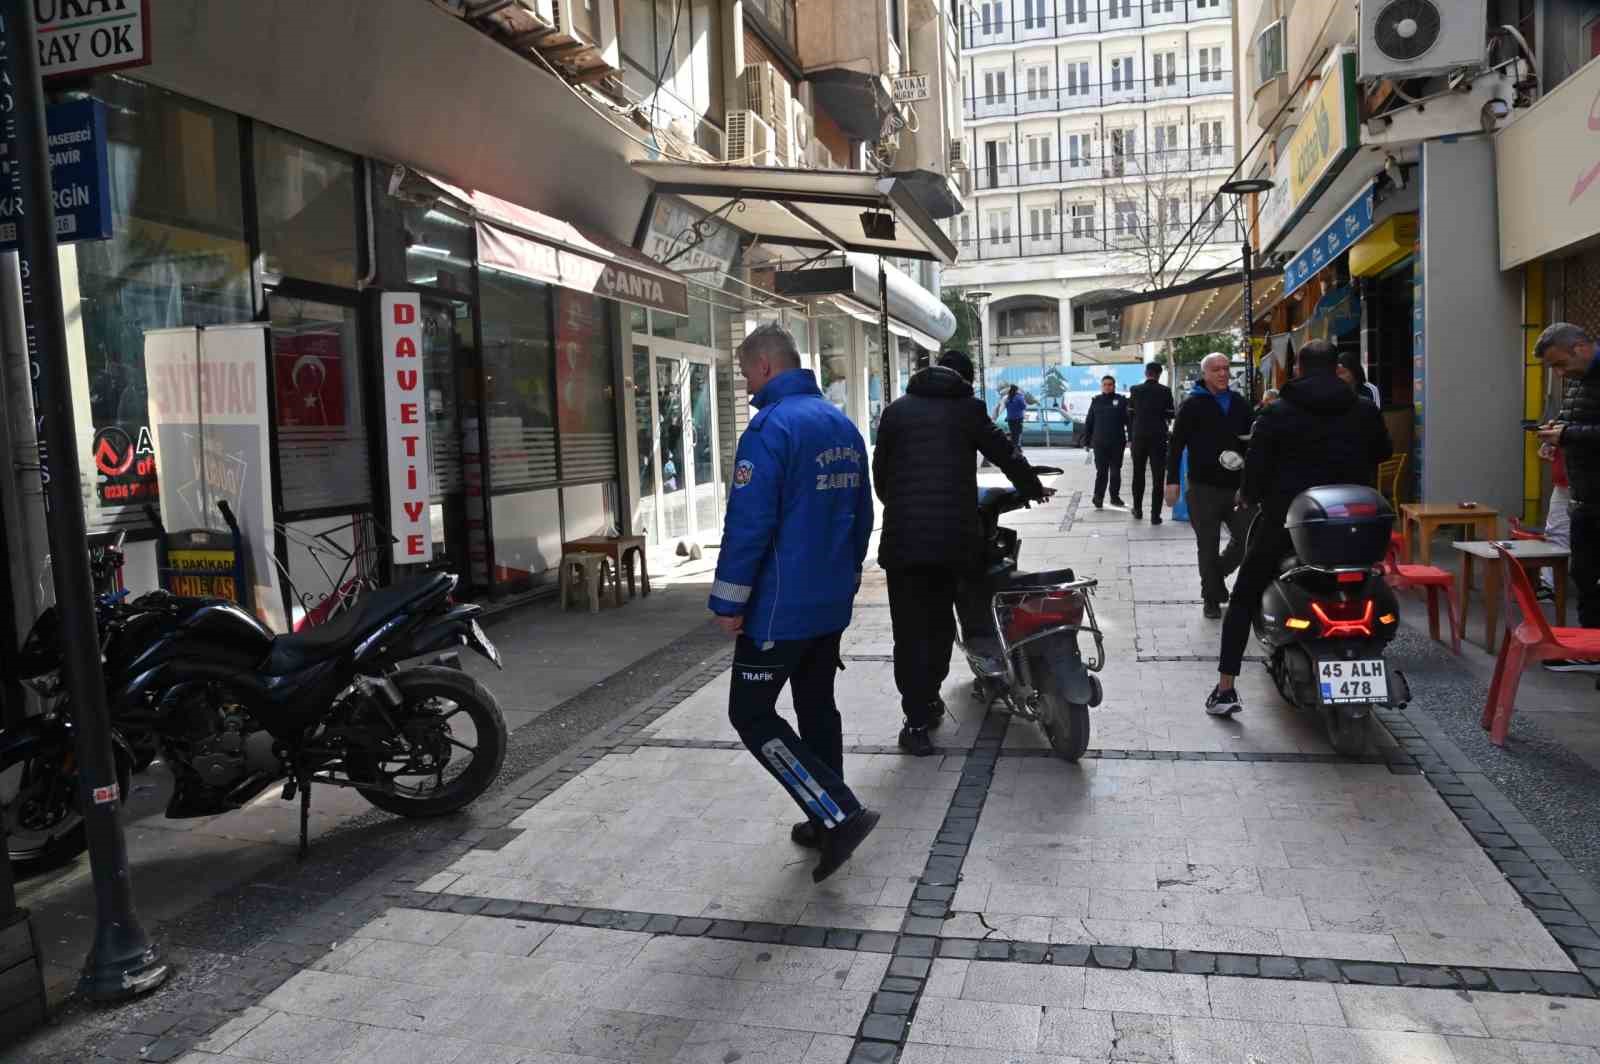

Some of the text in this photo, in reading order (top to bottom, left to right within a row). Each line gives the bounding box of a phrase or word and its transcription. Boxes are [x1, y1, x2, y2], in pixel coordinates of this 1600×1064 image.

[90, 24, 134, 58] OK
[50, 183, 90, 209] RGİN
[602, 265, 664, 304] ÇANTA
[136, 426, 155, 454] A
[393, 302, 425, 557] DAVETİYE
[1322, 662, 1383, 678] 45 ALH
[1340, 681, 1372, 696] 478
